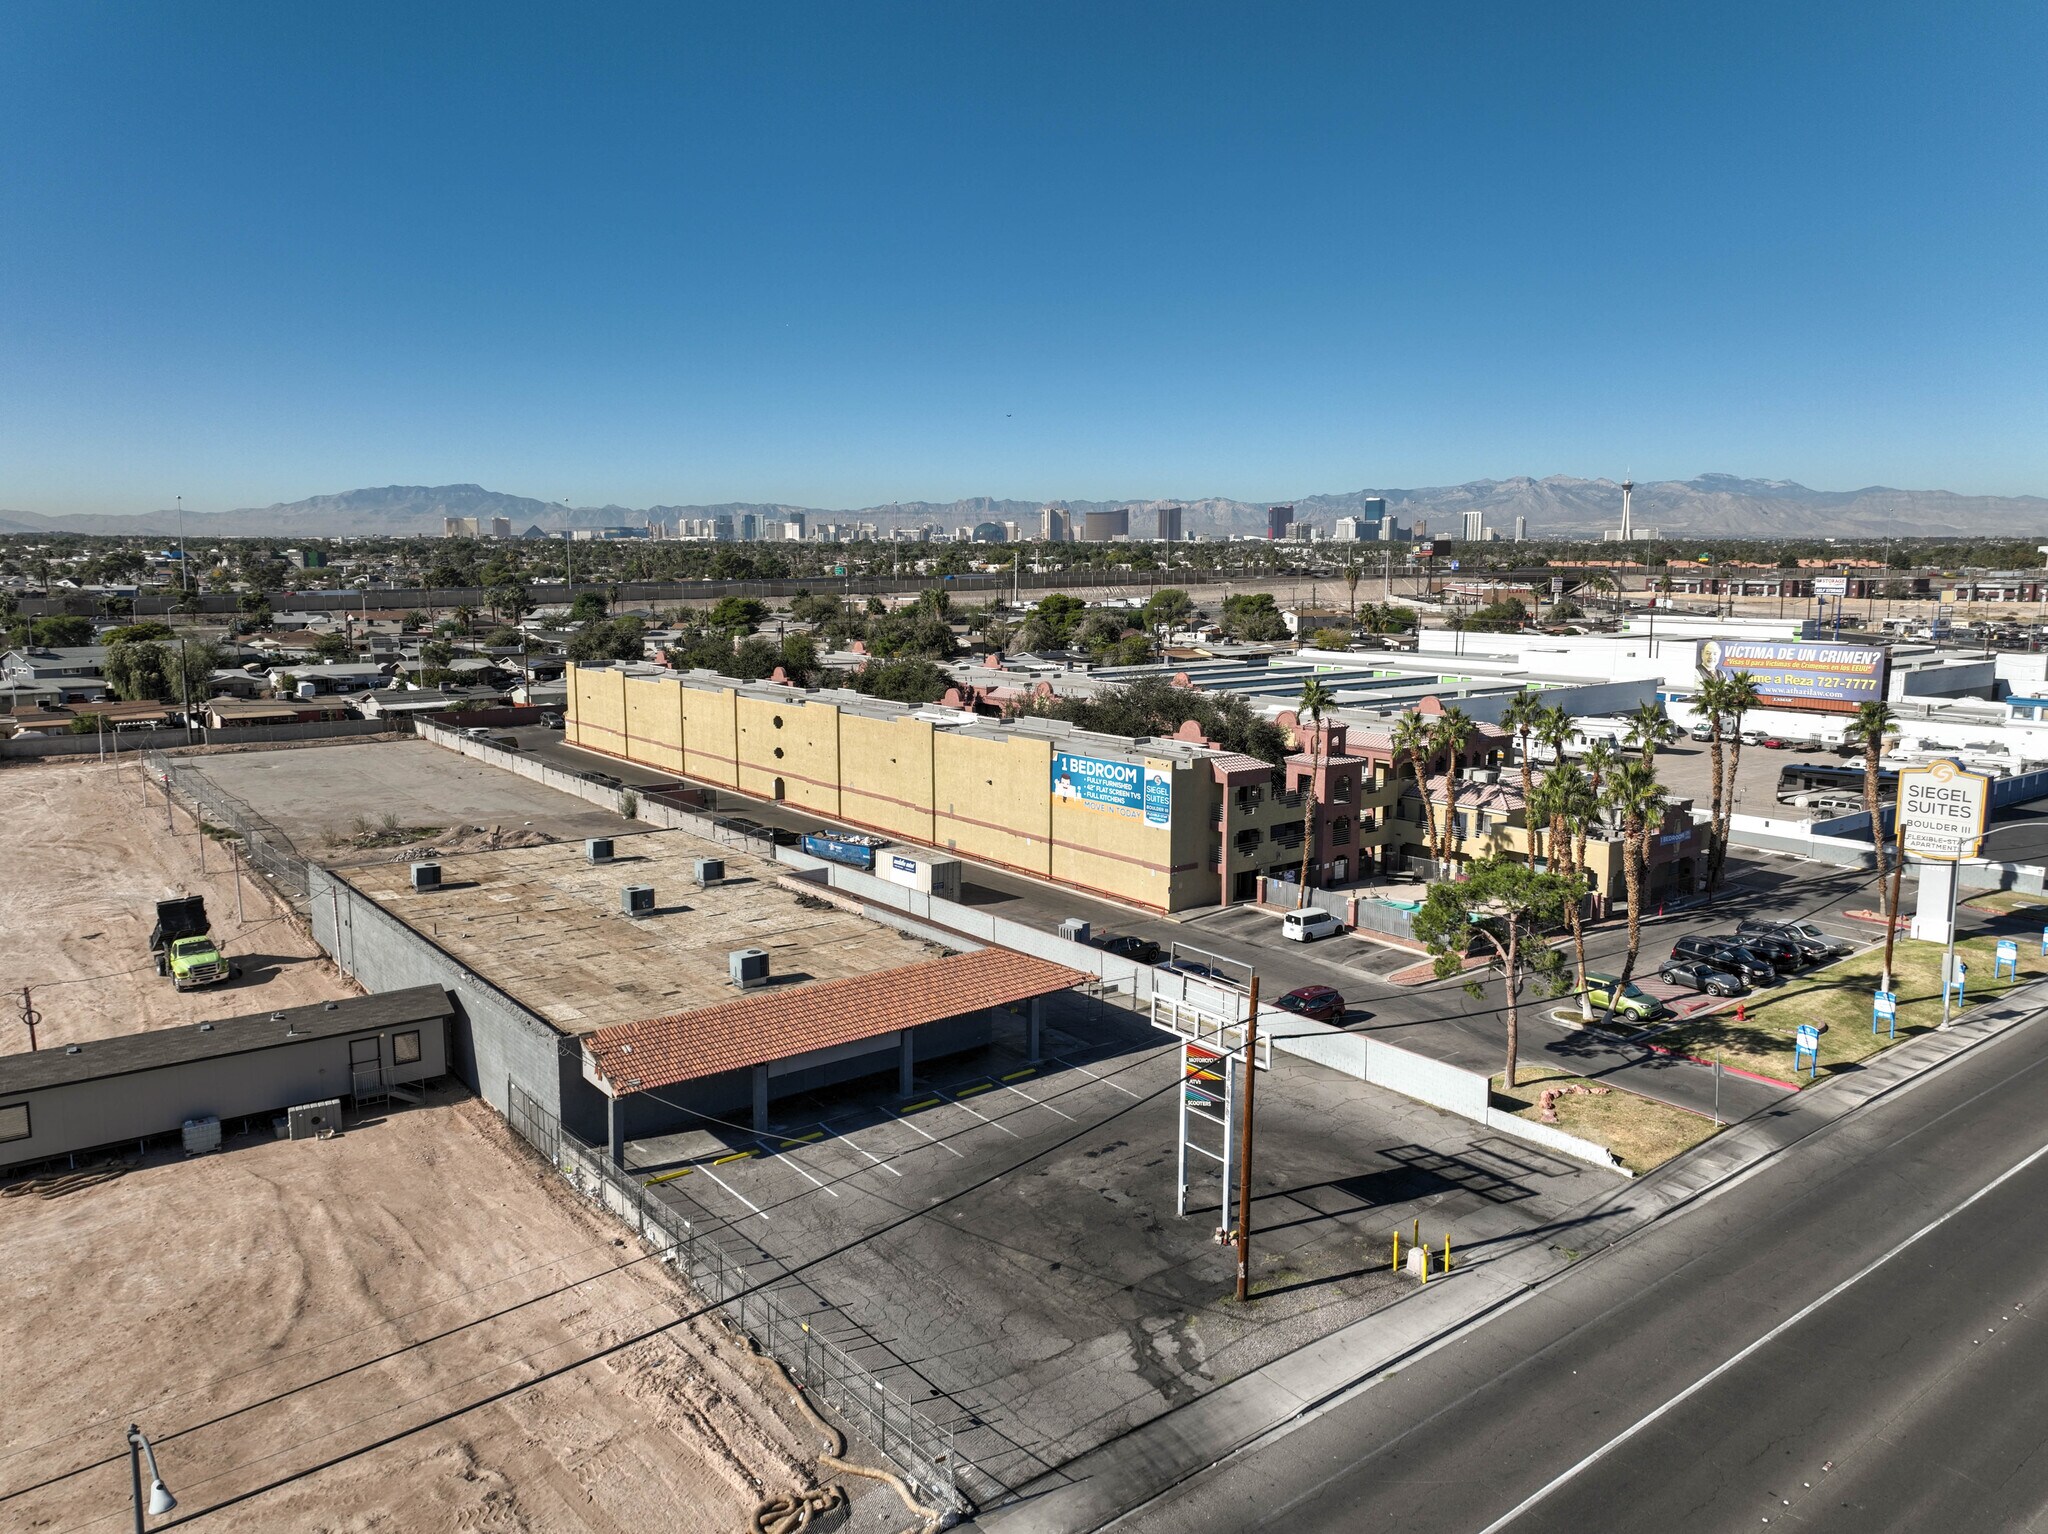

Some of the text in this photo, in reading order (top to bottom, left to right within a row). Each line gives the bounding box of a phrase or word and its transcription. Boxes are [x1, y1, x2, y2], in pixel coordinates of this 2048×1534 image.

[1725, 643, 1881, 665] VÍCTIMA DE UN CRIMEN?
[1774, 676, 1781, 684] a
[1784, 674, 1814, 686] Reza
[1817, 676, 1877, 690] 727-7777
[1765, 687, 1843, 698] www.atharilaw.com
[1061, 757, 1137, 784] 1 BEDROOM
[1086, 777, 1132, 790] FULLY FURNISHED
[1146, 785, 1169, 796] SIEGEL
[1086, 791, 1125, 804] FULL KITCHENS
[1096, 785, 1108, 794] FLAT
[1109, 788, 1130, 798] SCREEN
[1130, 791, 1141, 800] TVS
[1146, 794, 1169, 805] SUITES
[1908, 785, 1972, 803] SIEGEL
[1084, 801, 1141, 818] MOVE IN TODAY
[1907, 800, 1971, 818] SUITES
[1907, 820, 1971, 834] BOULDER III
[1910, 841, 1961, 852] APARTMENT
